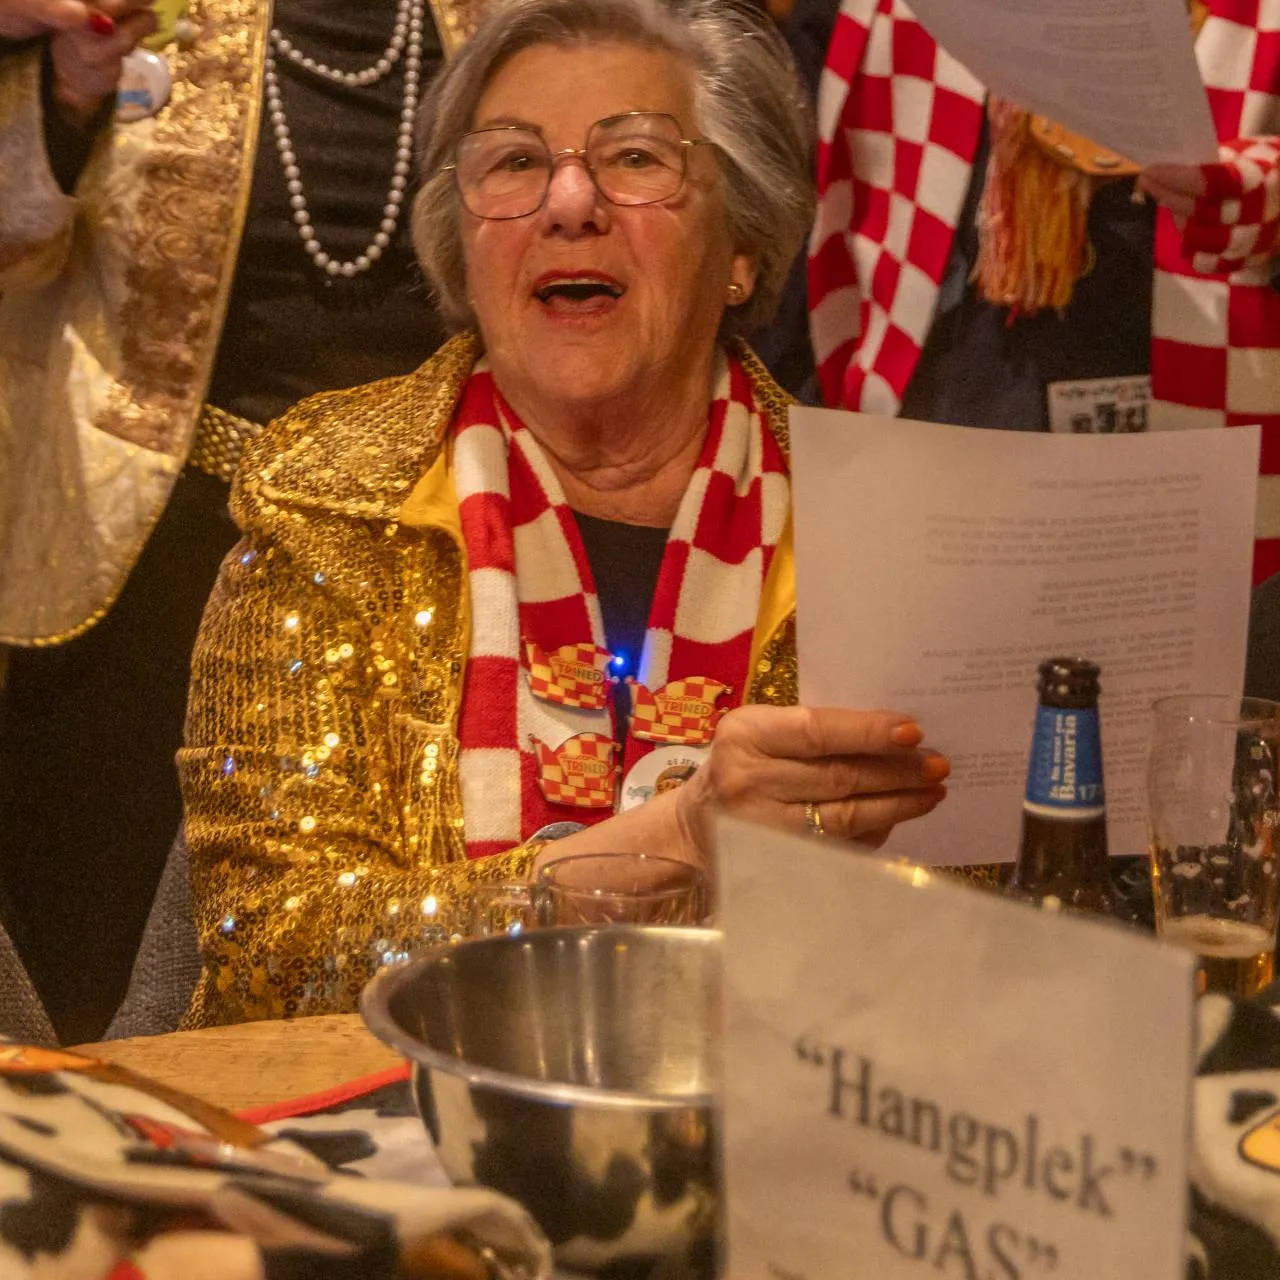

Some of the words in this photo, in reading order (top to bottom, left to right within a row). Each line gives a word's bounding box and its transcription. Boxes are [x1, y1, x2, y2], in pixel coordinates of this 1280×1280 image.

[558, 663, 601, 680] TRINED
[663, 701, 710, 715] TRINED
[566, 760, 606, 774] TRINED
[1058, 714, 1077, 801] Bavaria
[792, 1035, 1158, 1218] “Hangplek”
[847, 1167, 1060, 1280] “GAS”
